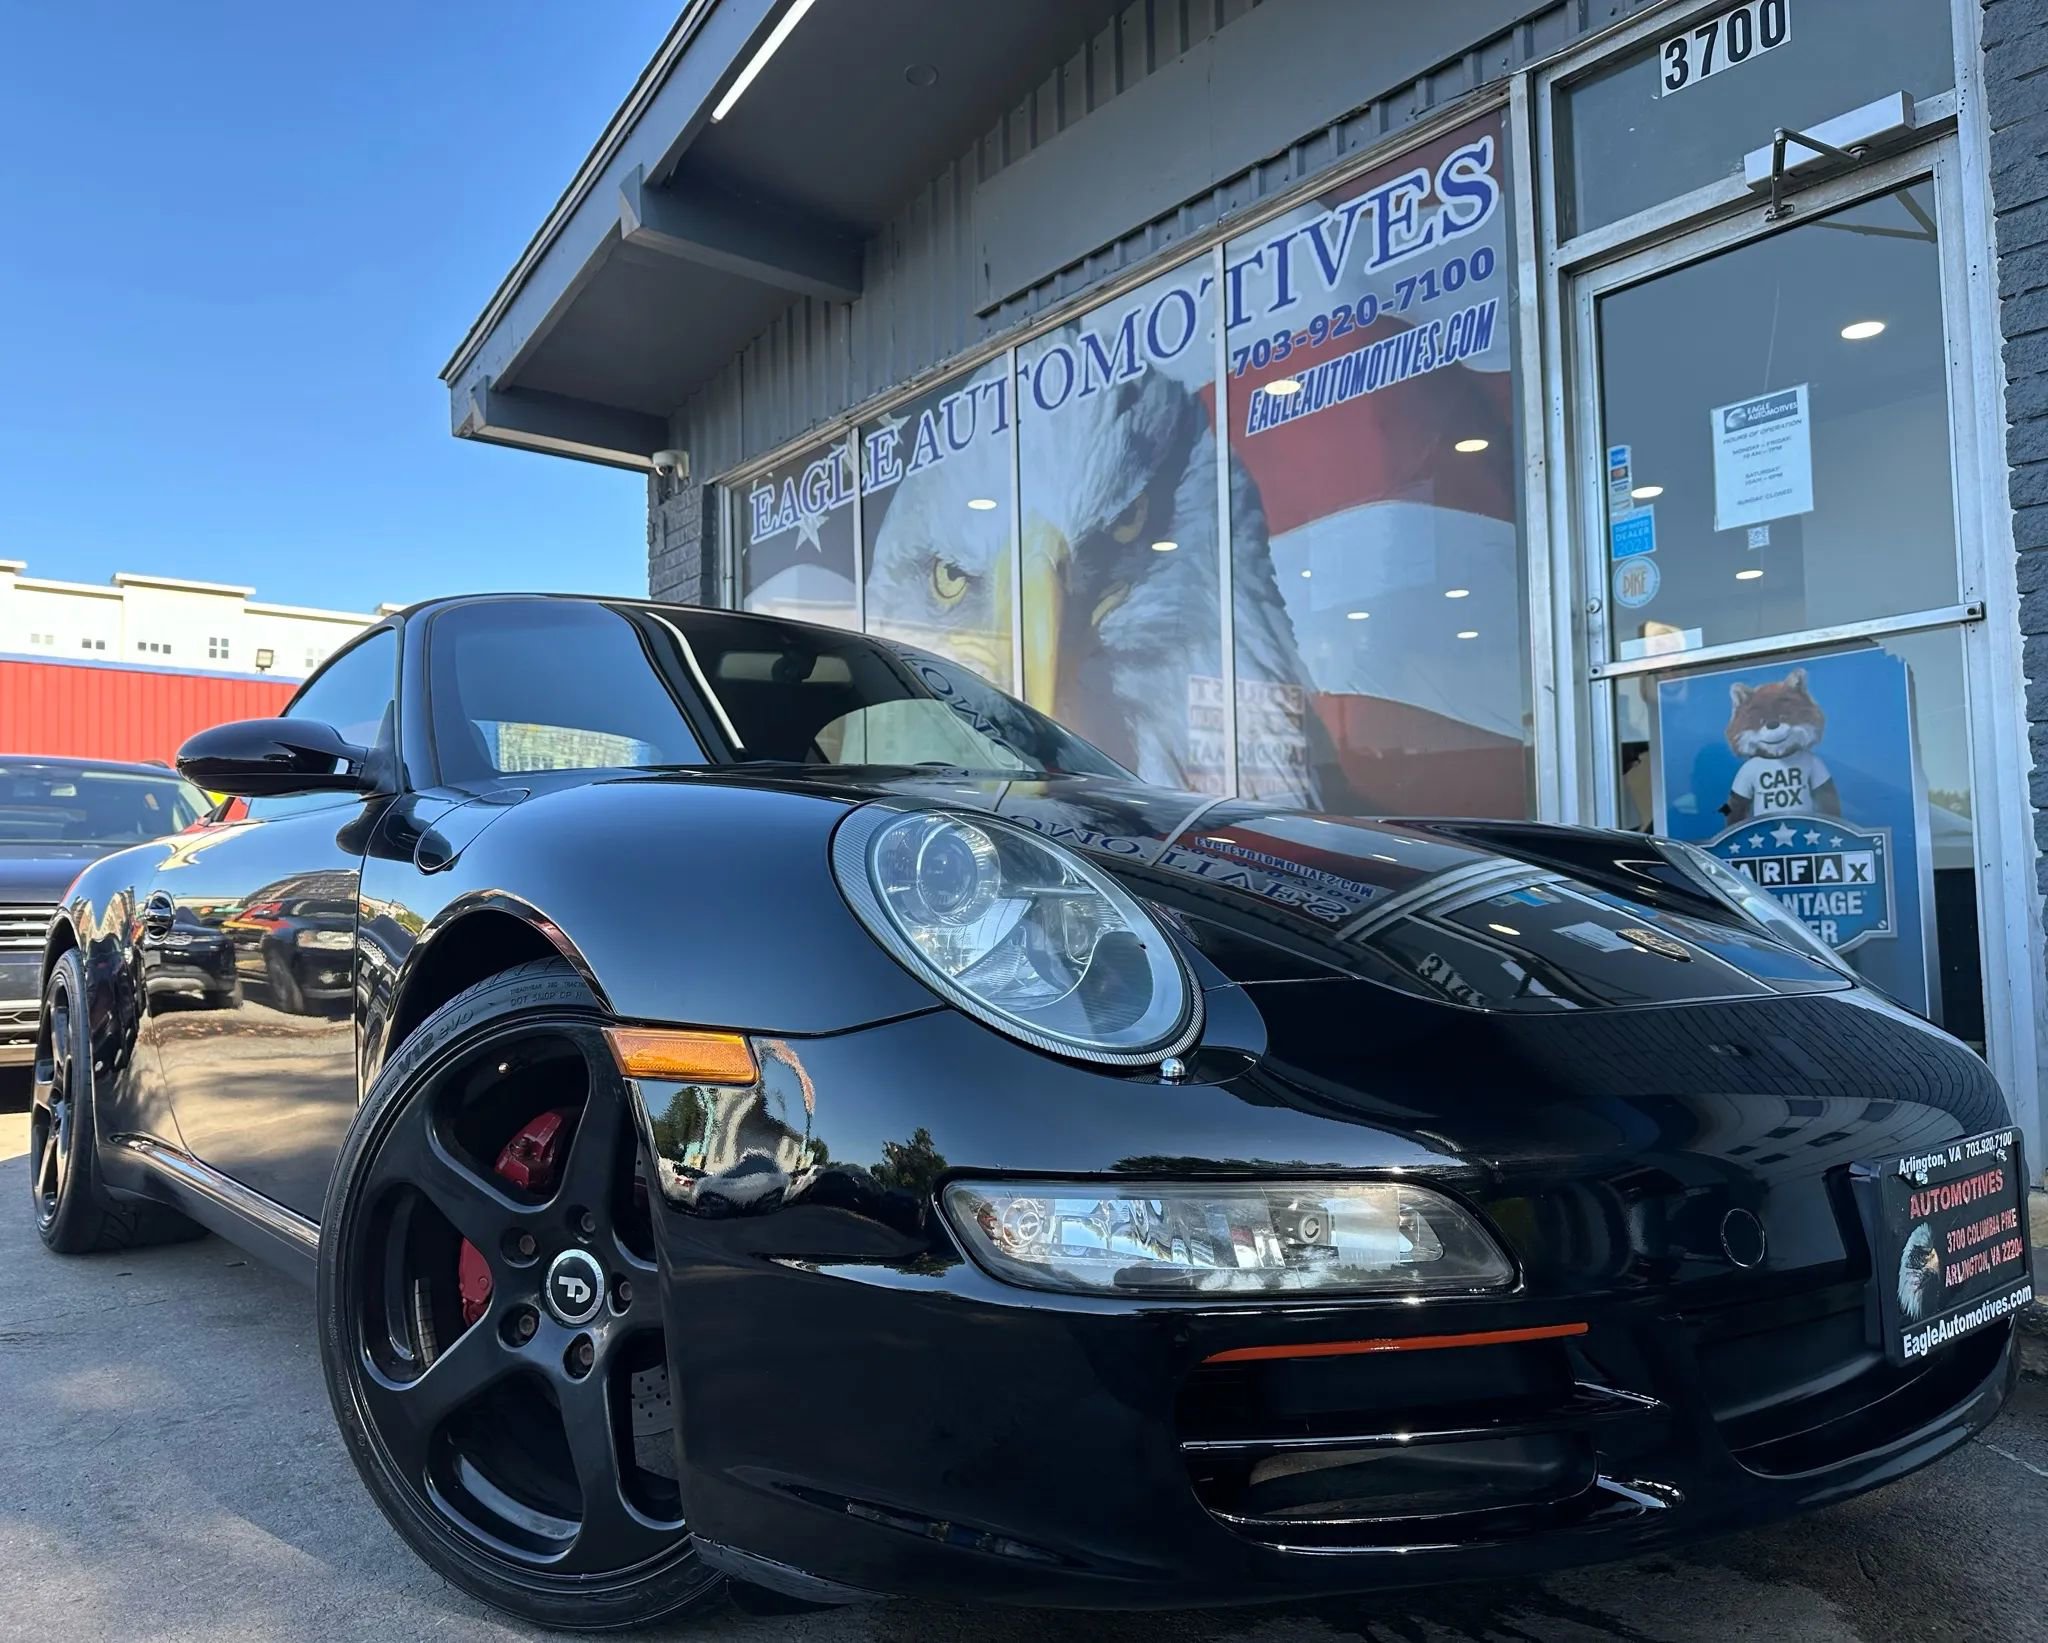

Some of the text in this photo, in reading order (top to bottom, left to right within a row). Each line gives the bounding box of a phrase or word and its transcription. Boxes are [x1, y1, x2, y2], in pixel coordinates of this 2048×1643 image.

[1664, 0, 1786, 91] 3700
[1233, 247, 1495, 377] 703-920-7100
[749, 135, 1500, 546] EAGLE AUTOMOTIVES
[1245, 297, 1499, 437] EAGLEAUTOMOTIVES.COM
[1747, 402, 1770, 415] EAGLE
[1760, 767, 1803, 790] CAR
[1763, 788, 1803, 809] FOX
[1737, 859, 1869, 885] ARFAX
[397, 1031, 436, 1074] V12
[1899, 1131, 2013, 1176] Arlington, VA 703.920.7100
[1909, 1168, 2004, 1220] AUTOMOTIVES
[1946, 1207, 2018, 1254] 3700 COLUMBIA PIKE
[1990, 1244, 2001, 1266] VA
[1903, 1284, 2033, 1359] EagleAutomotives.com
